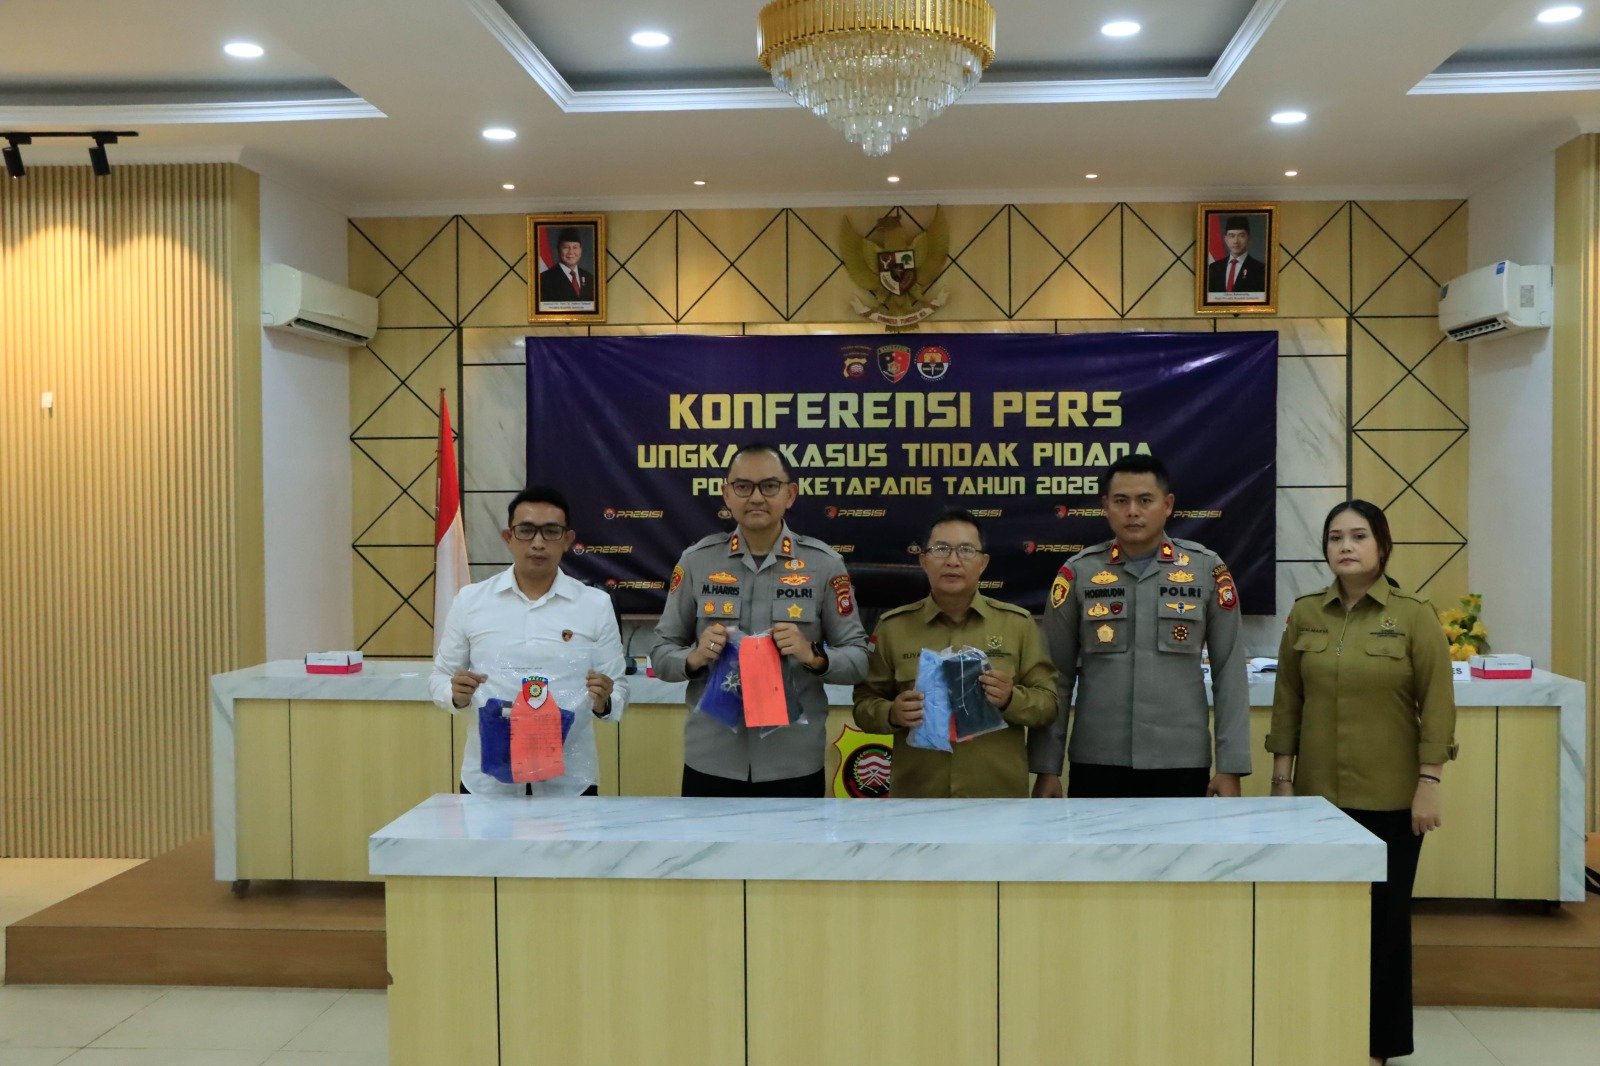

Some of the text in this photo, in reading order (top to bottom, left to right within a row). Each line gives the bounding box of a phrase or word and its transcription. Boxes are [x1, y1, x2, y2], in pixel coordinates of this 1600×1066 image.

[669, 391, 1122, 430] KONFERENSI PERS
[637, 444, 738, 468] UNGKA
[779, 443, 888, 468] KASUS
[902, 442, 1018, 468] TINDAK
[797, 477, 933, 496] KETAPANG
[942, 476, 1025, 496] TAHUN
[1035, 476, 1099, 496] 2026
[616, 510, 664, 519] PRESISI
[838, 509, 887, 518] PRESISI
[1173, 510, 1223, 519] PRESISI
[585, 546, 633, 555] PRESISI
[618, 581, 666, 590] PRESISI
[776, 588, 813, 599] POLRI
[1159, 586, 1201, 598] POLRI
